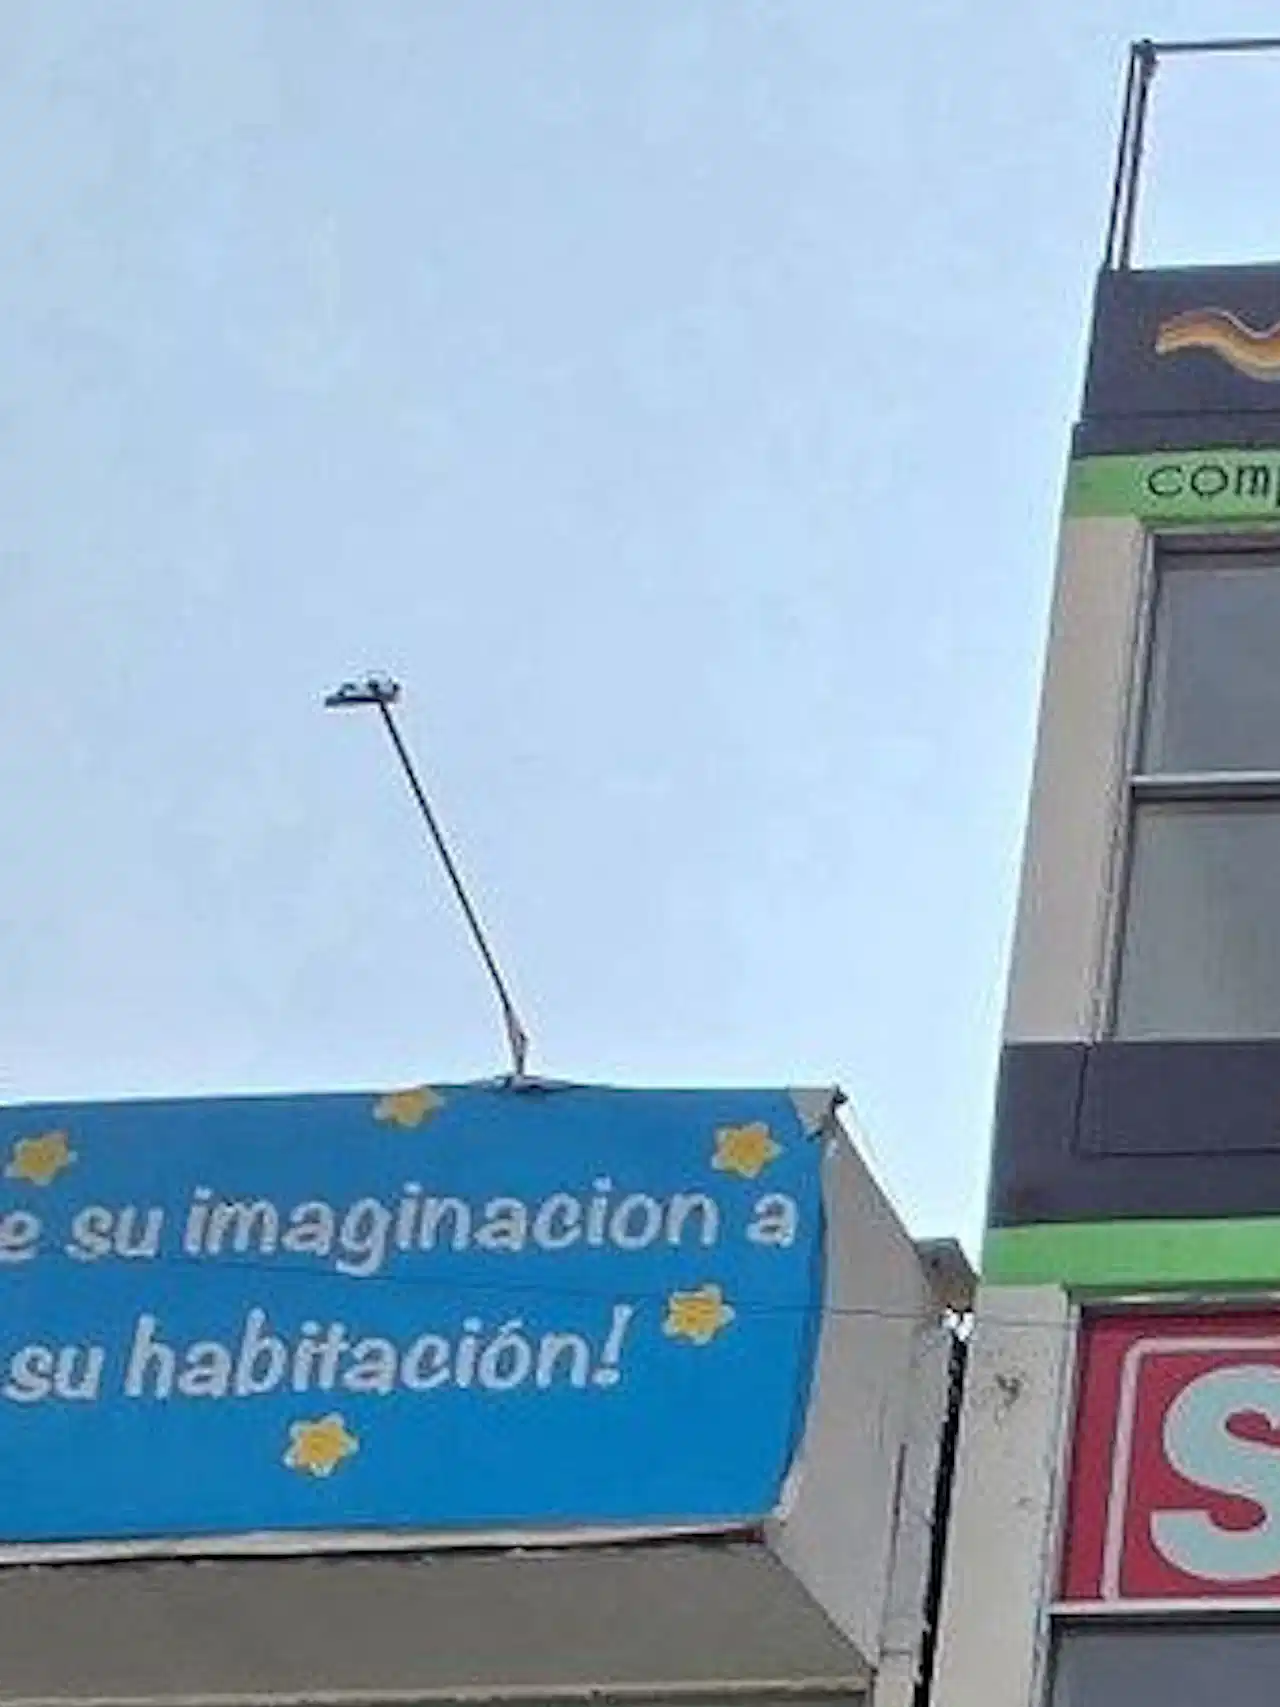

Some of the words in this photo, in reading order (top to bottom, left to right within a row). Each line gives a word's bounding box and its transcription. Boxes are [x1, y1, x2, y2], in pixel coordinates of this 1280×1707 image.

[65, 1205, 165, 1262] su
[182, 1175, 720, 1278] imaginacion
[745, 1191, 799, 1249] a
[2, 1344, 105, 1402] su
[124, 1304, 635, 1400] habitación!
